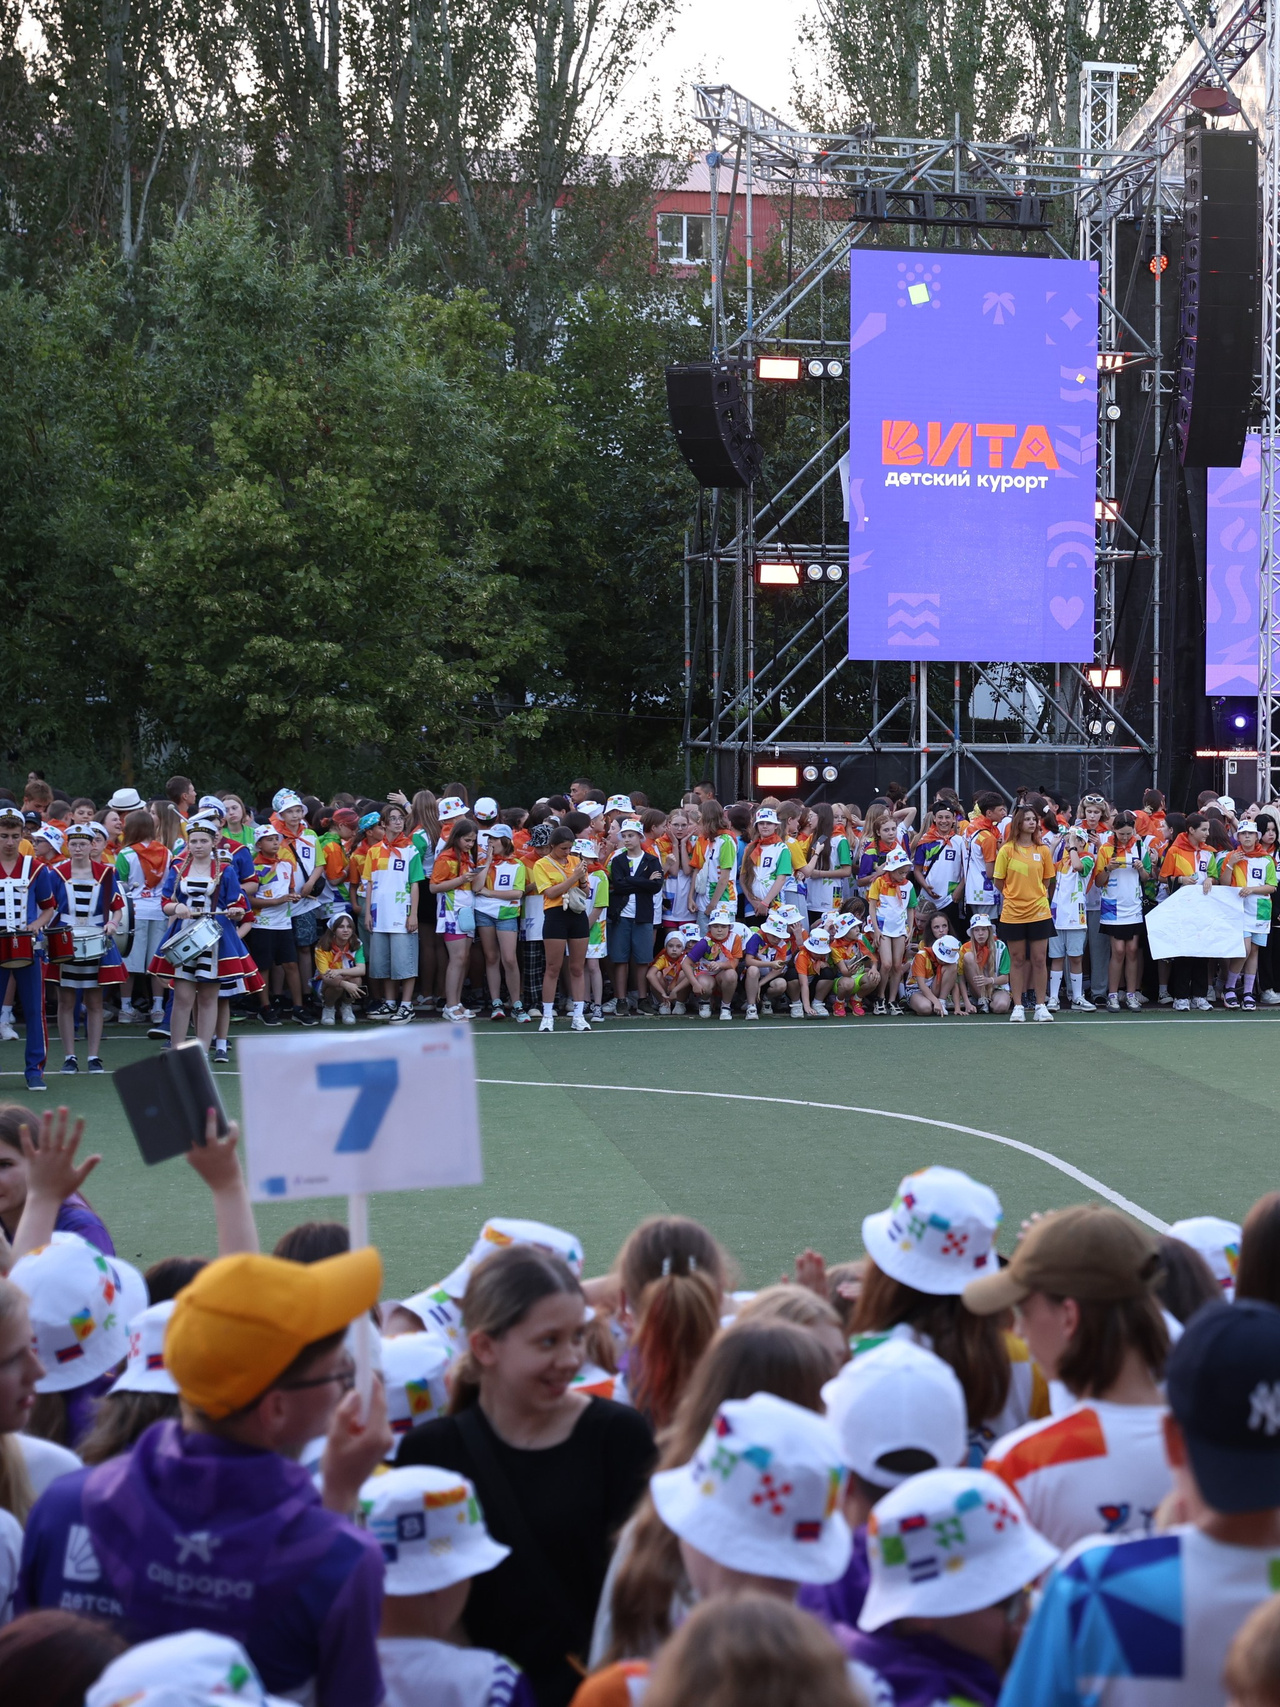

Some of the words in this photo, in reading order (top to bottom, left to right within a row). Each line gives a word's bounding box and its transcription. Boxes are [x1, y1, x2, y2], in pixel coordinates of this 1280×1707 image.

[881, 420, 1061, 470] ВИТА
[885, 469, 971, 488] детский
[977, 473, 1049, 493] курорт
[316, 1057, 401, 1155] 7
[147, 1562, 254, 1599] аврора
[60, 1591, 124, 1617] детск
